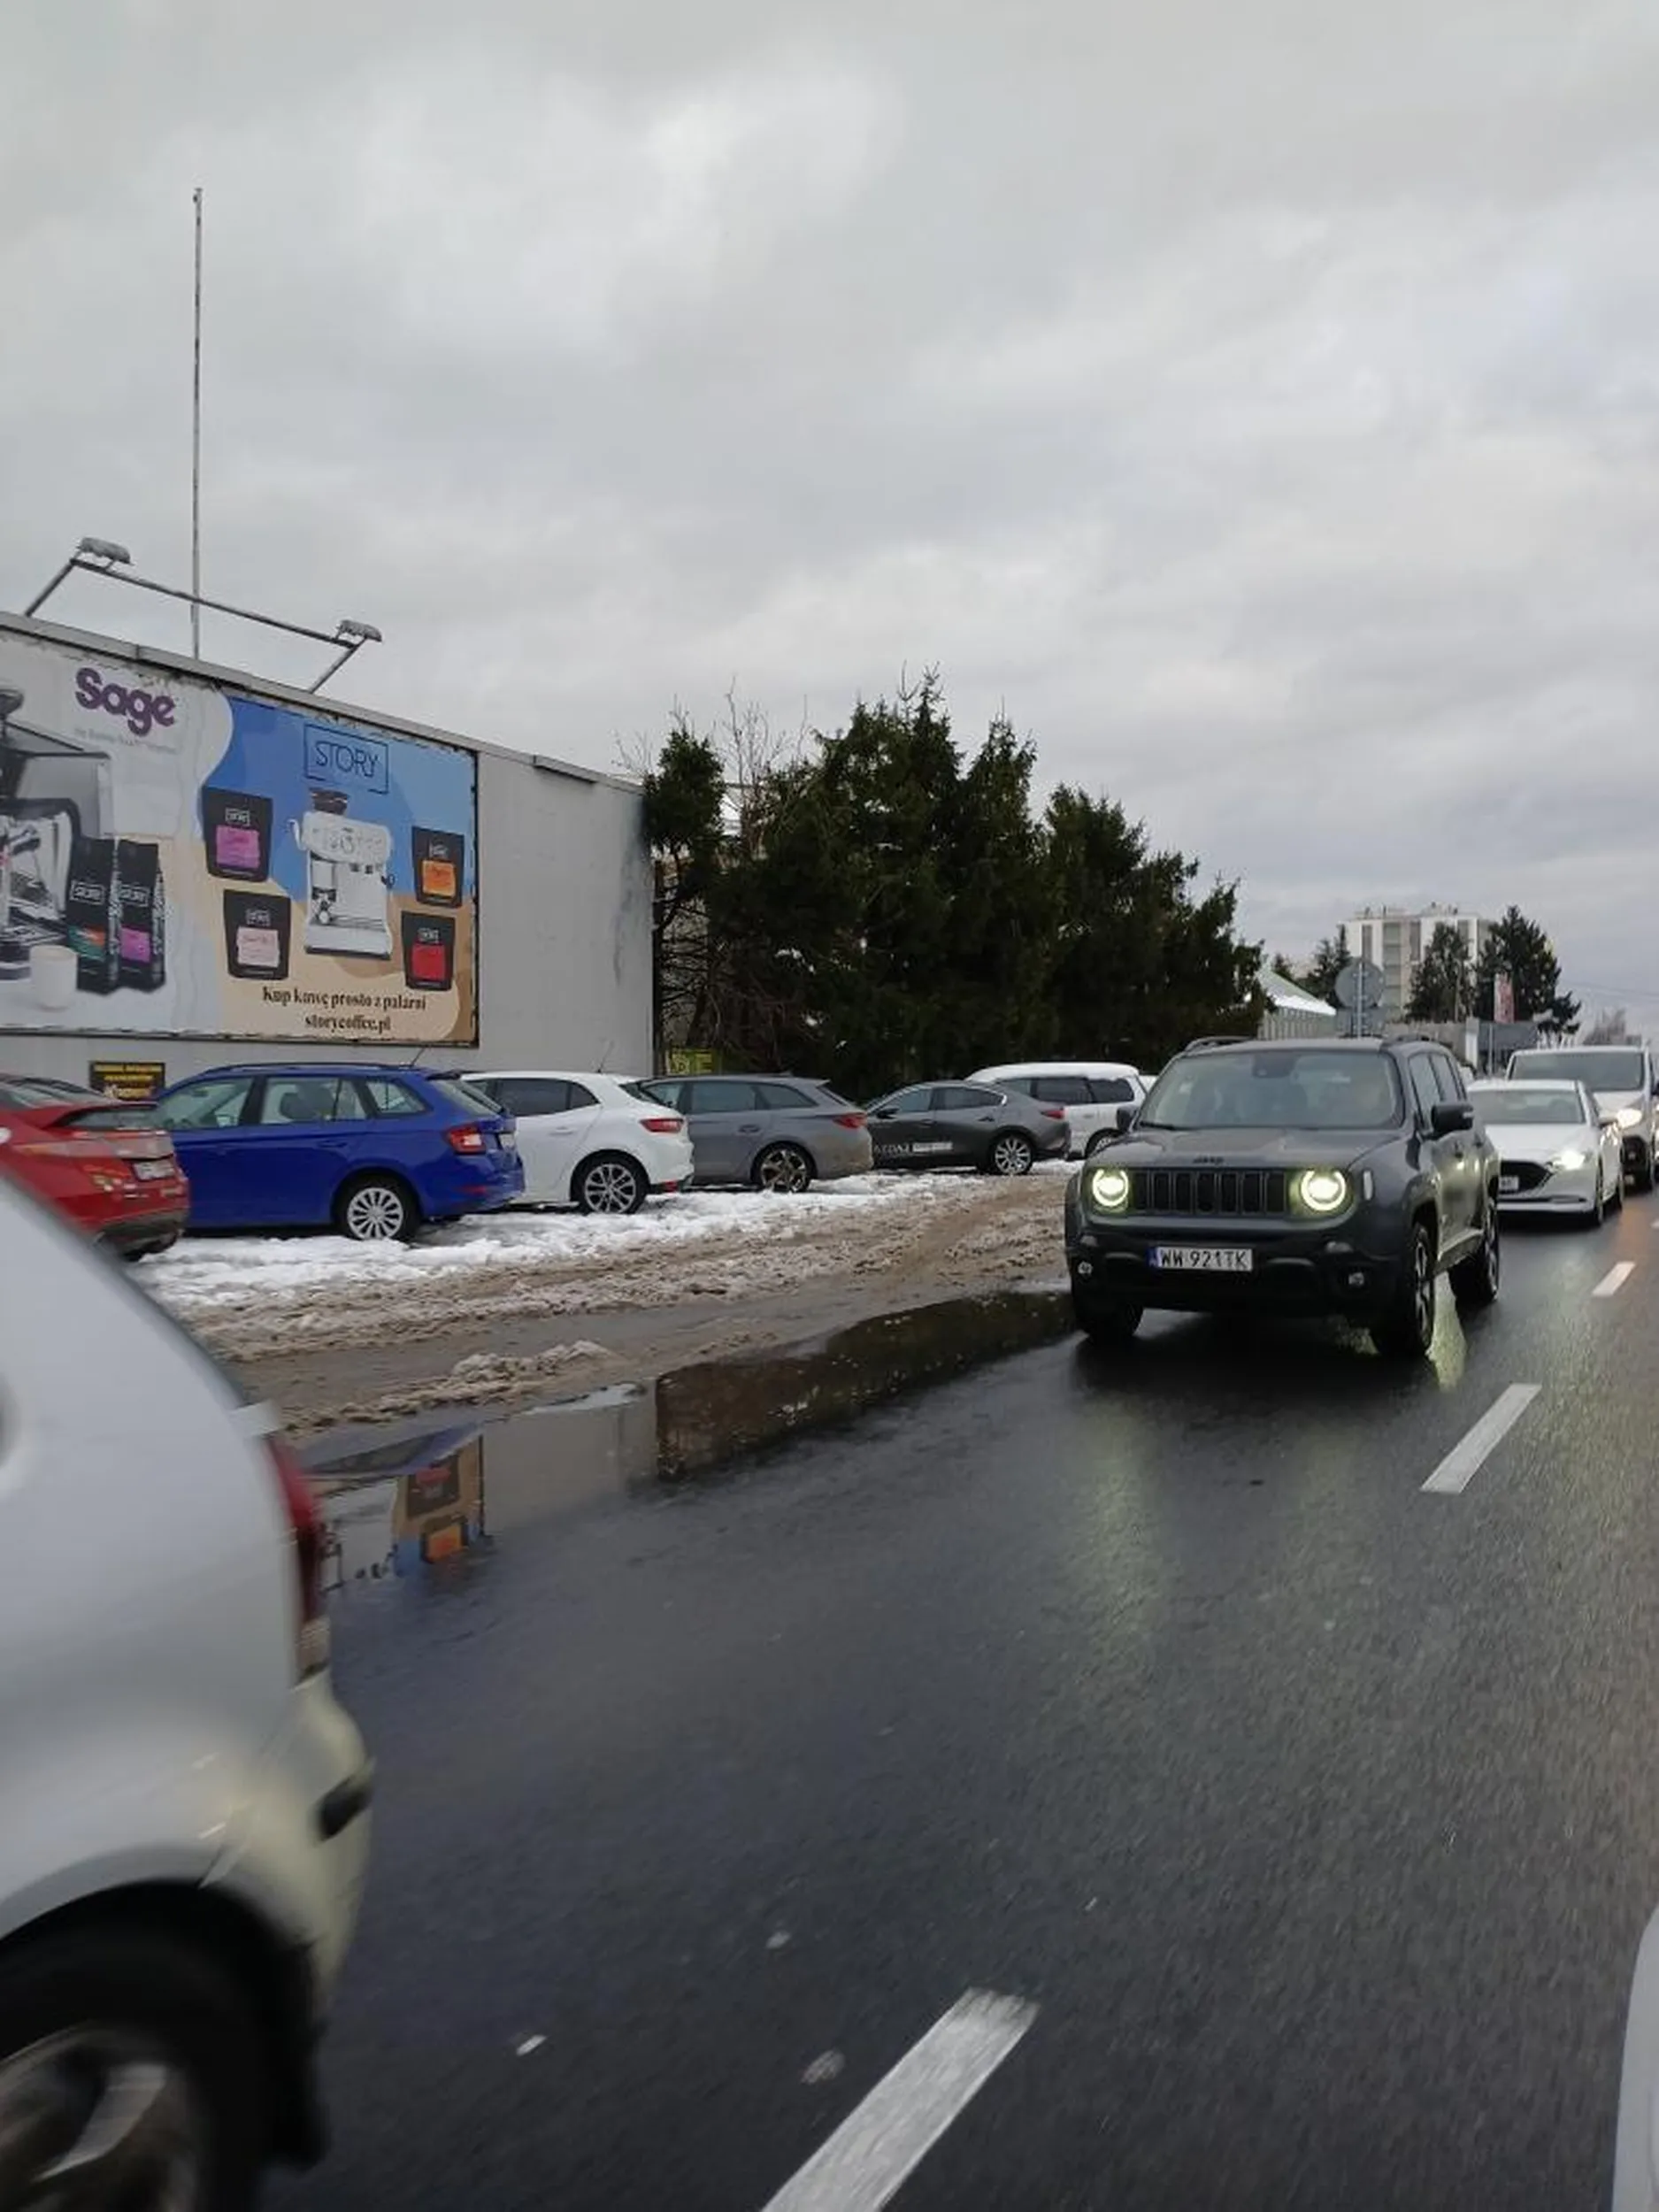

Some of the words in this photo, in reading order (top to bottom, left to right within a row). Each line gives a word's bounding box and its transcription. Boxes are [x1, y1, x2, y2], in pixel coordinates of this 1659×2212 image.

[315, 741, 380, 778] STORY
[263, 987, 291, 1007] Kup
[294, 987, 328, 1010] kawę
[331, 992, 372, 1010] prosto
[374, 996, 381, 1007] z
[383, 995, 426, 1011] palarni
[305, 1014, 391, 1034] storycoffee.pl
[1162, 1249, 1183, 1268] WW
[1190, 1250, 1248, 1269] 921TK
